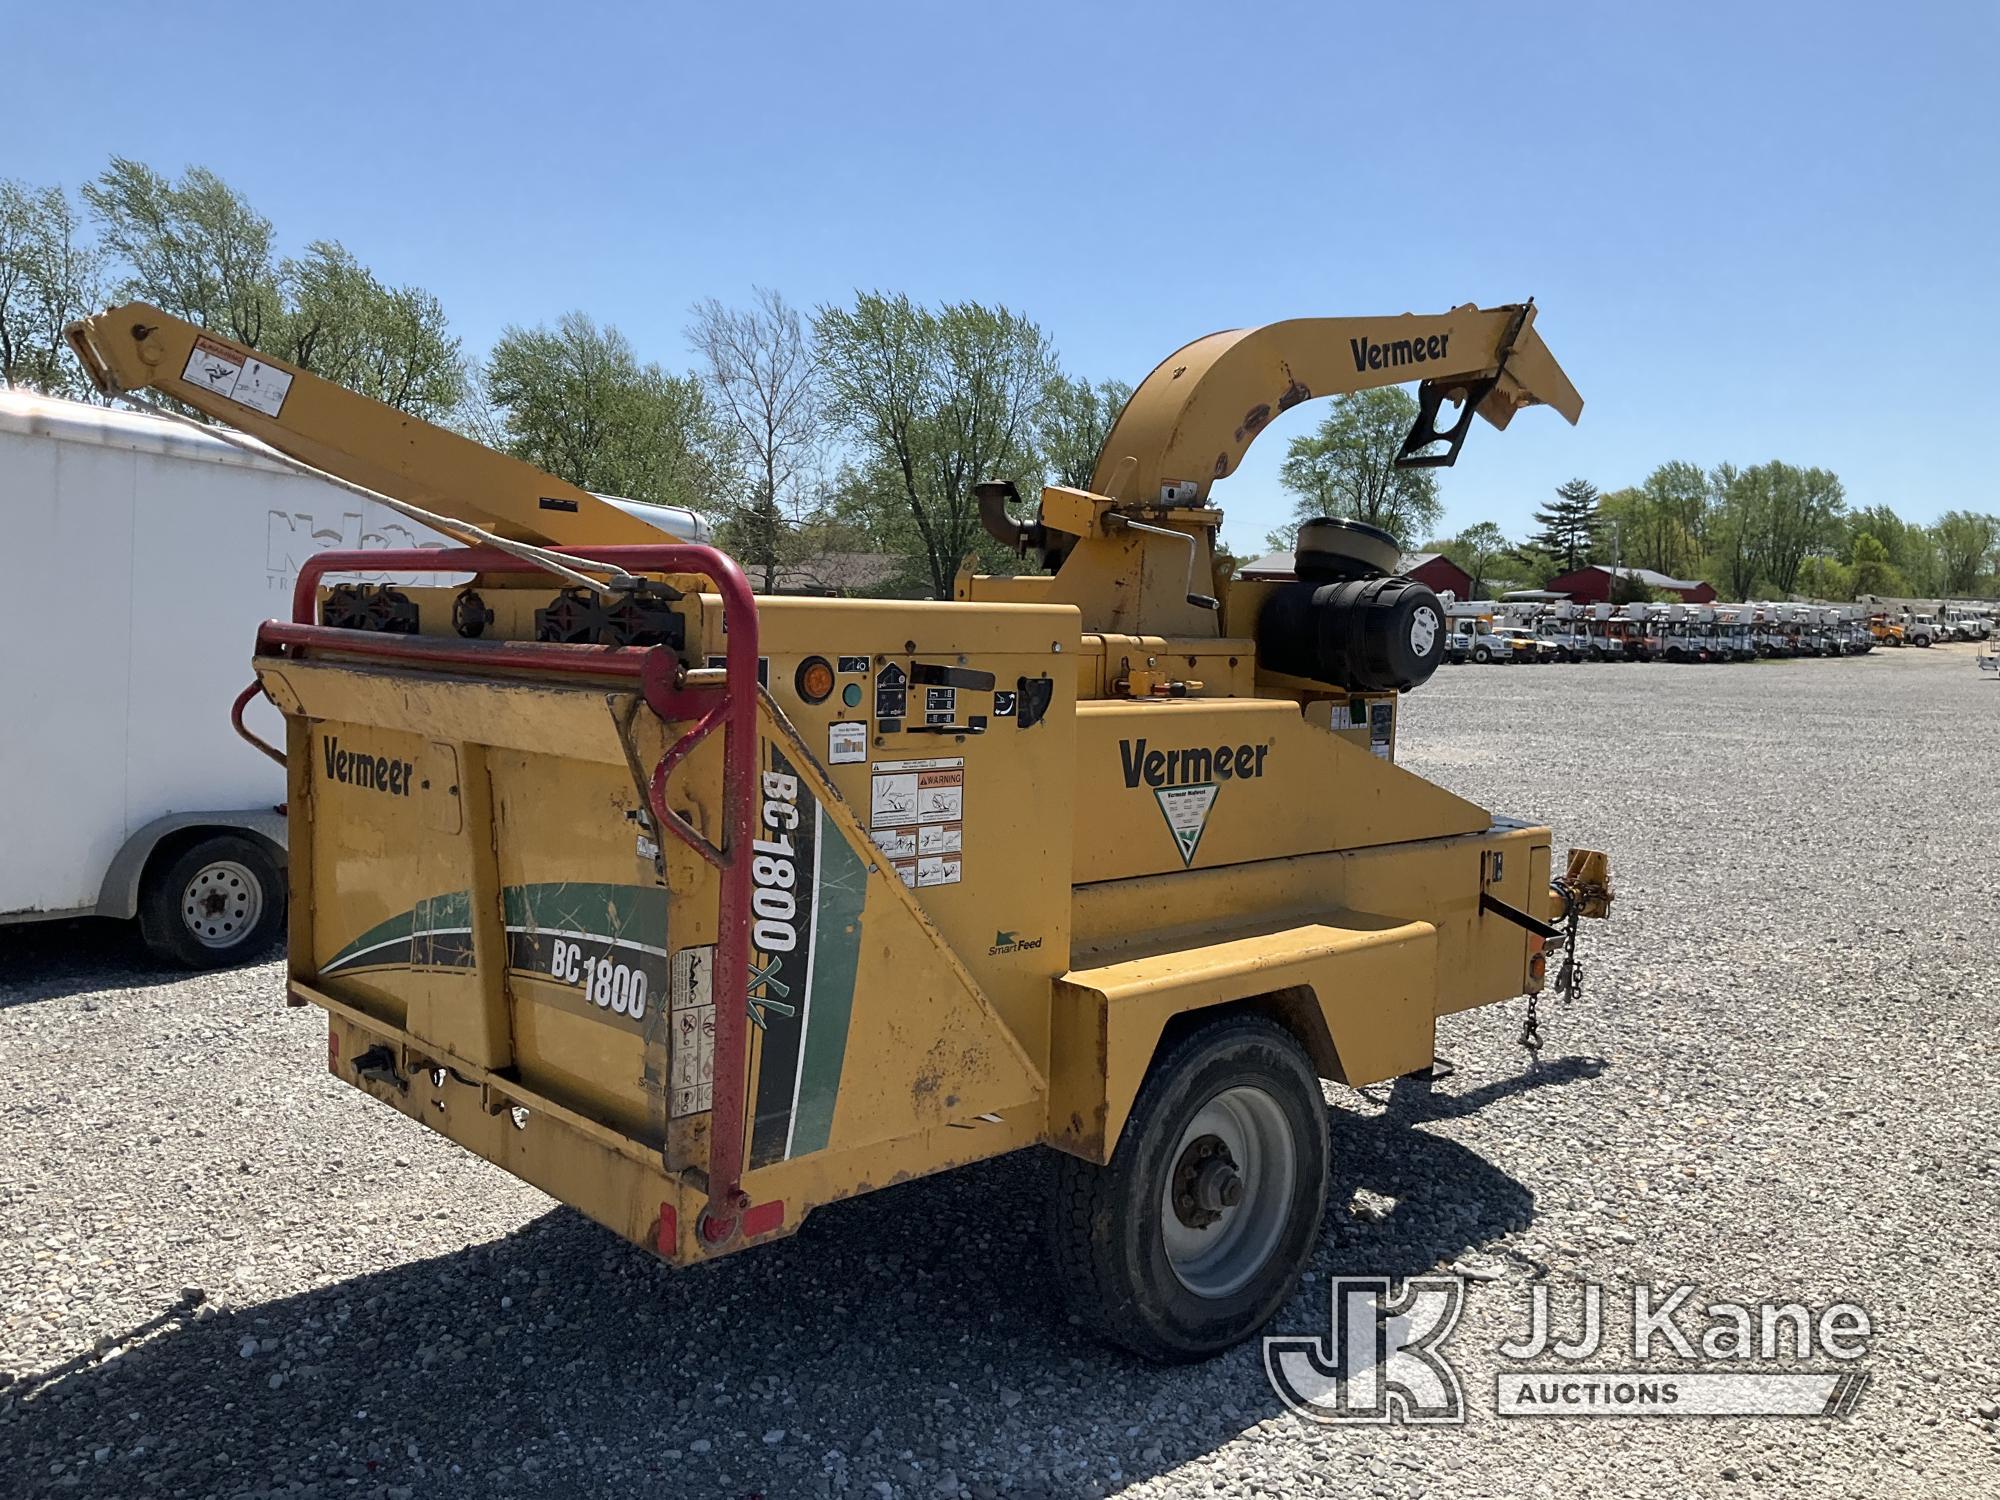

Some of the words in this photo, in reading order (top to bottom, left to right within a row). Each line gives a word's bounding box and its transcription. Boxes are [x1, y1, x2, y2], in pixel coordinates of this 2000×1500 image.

[1350, 334, 1449, 372] Vermeer
[324, 735, 413, 797] Vermeer
[927, 775, 962, 786] WARNING
[1119, 738, 1268, 788] Vermeer
